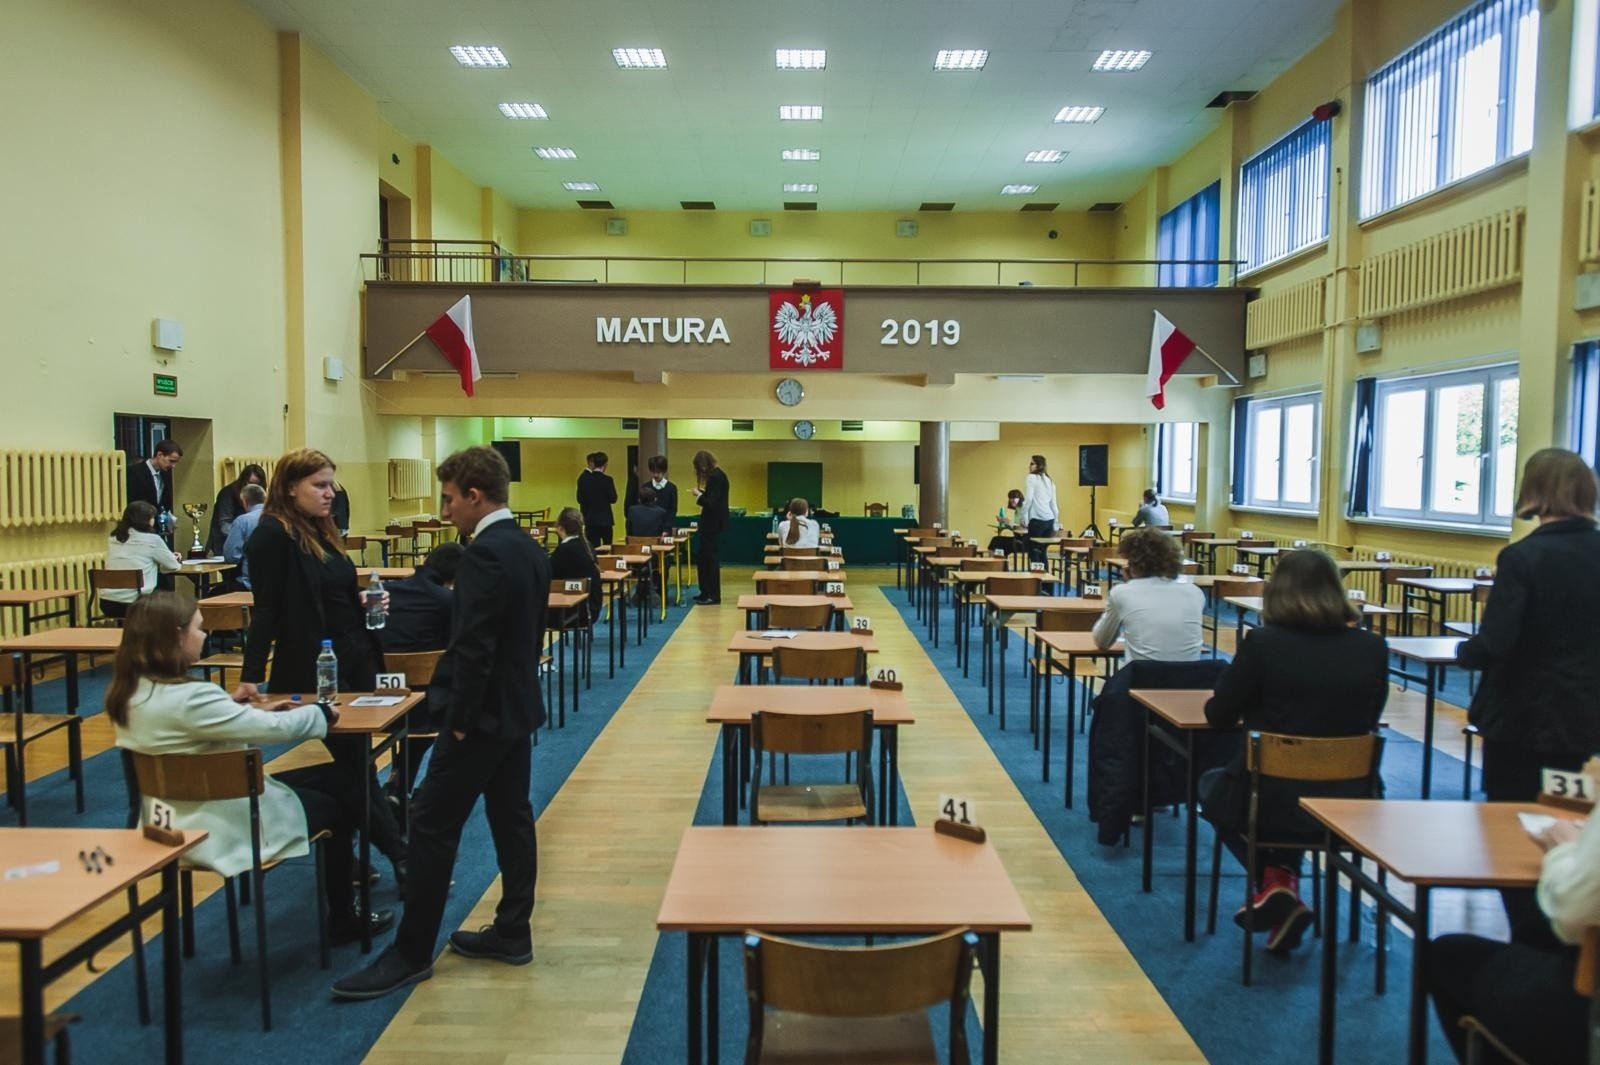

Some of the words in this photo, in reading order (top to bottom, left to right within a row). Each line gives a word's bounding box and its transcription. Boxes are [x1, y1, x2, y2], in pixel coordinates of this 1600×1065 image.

[597, 316, 731, 344] MATURA
[880, 318, 961, 346] 2019
[569, 583, 579, 591] 48
[830, 584, 841, 593] 38
[856, 618, 868, 629] 39
[877, 669, 896, 682] 40
[379, 676, 400, 689] 50
[1551, 775, 1587, 799] 31
[154, 804, 171, 831] 51
[943, 799, 971, 824] 41
